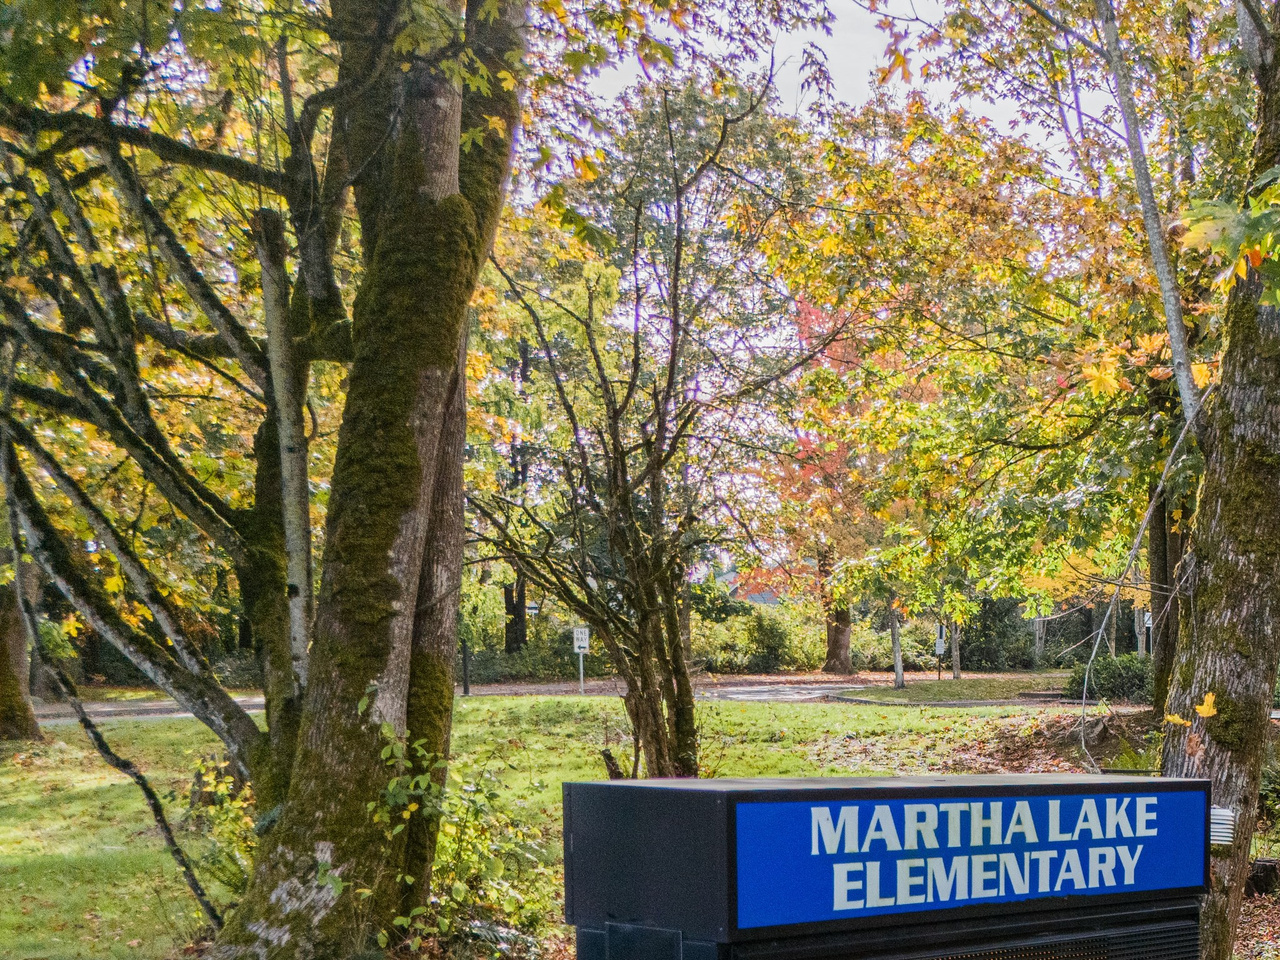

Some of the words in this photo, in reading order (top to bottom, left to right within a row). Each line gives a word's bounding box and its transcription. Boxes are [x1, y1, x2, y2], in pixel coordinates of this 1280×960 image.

[811, 800, 1039, 855] MARTHA
[1048, 797, 1158, 842] LAKE
[833, 845, 1143, 911] ELEMENTARY
